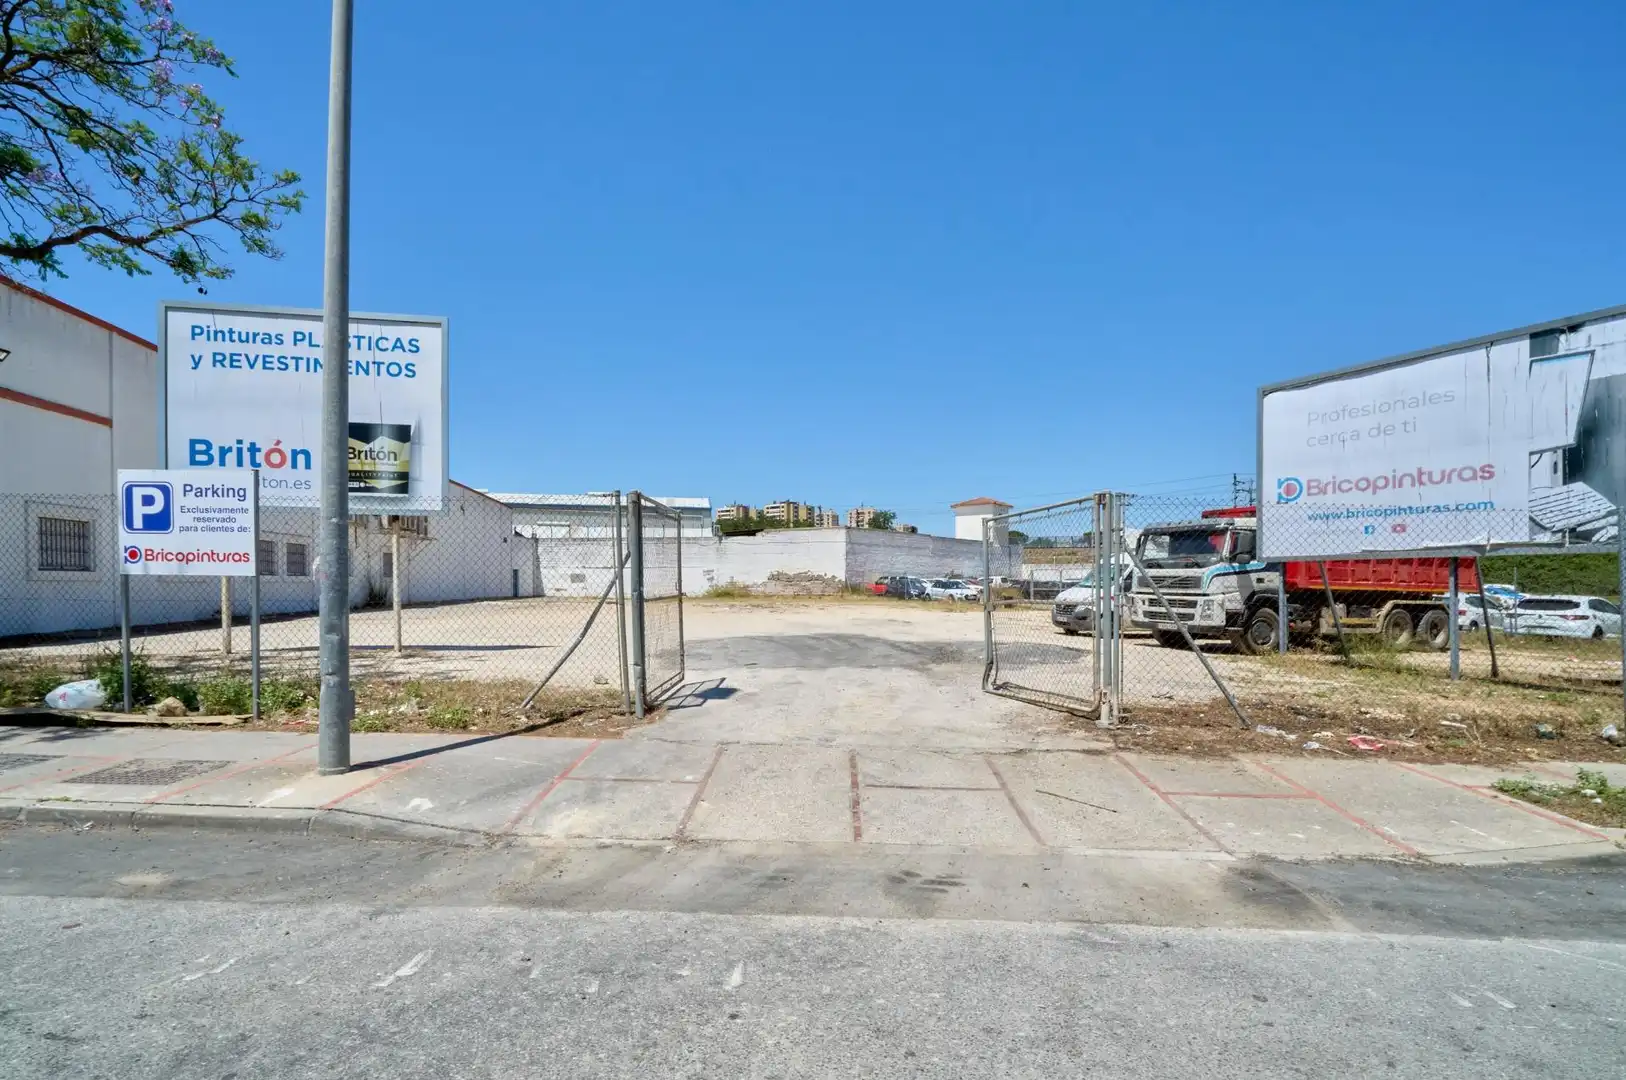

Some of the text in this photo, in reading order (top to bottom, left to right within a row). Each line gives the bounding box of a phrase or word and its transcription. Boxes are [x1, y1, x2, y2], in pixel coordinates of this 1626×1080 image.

[190, 324, 420, 353] Pinturas PLTICAS
[190, 352, 417, 378] y REVESTINTOS
[1307, 390, 1456, 426] Profesionales
[1306, 416, 1418, 447] cerca de ti
[189, 438, 312, 470] Britón
[348, 446, 398, 461] Britón
[1306, 463, 1496, 497] Bricopinturas
[183, 483, 247, 502] Parking
[132, 486, 165, 529] P
[180, 505, 249, 515] Exclusivamente
[1307, 500, 1495, 521] www.bricopinturas.com
[179, 524, 251, 533] para clientes de:
[193, 515, 237, 524] reservado
[144, 548, 250, 565] Bricopinturas
